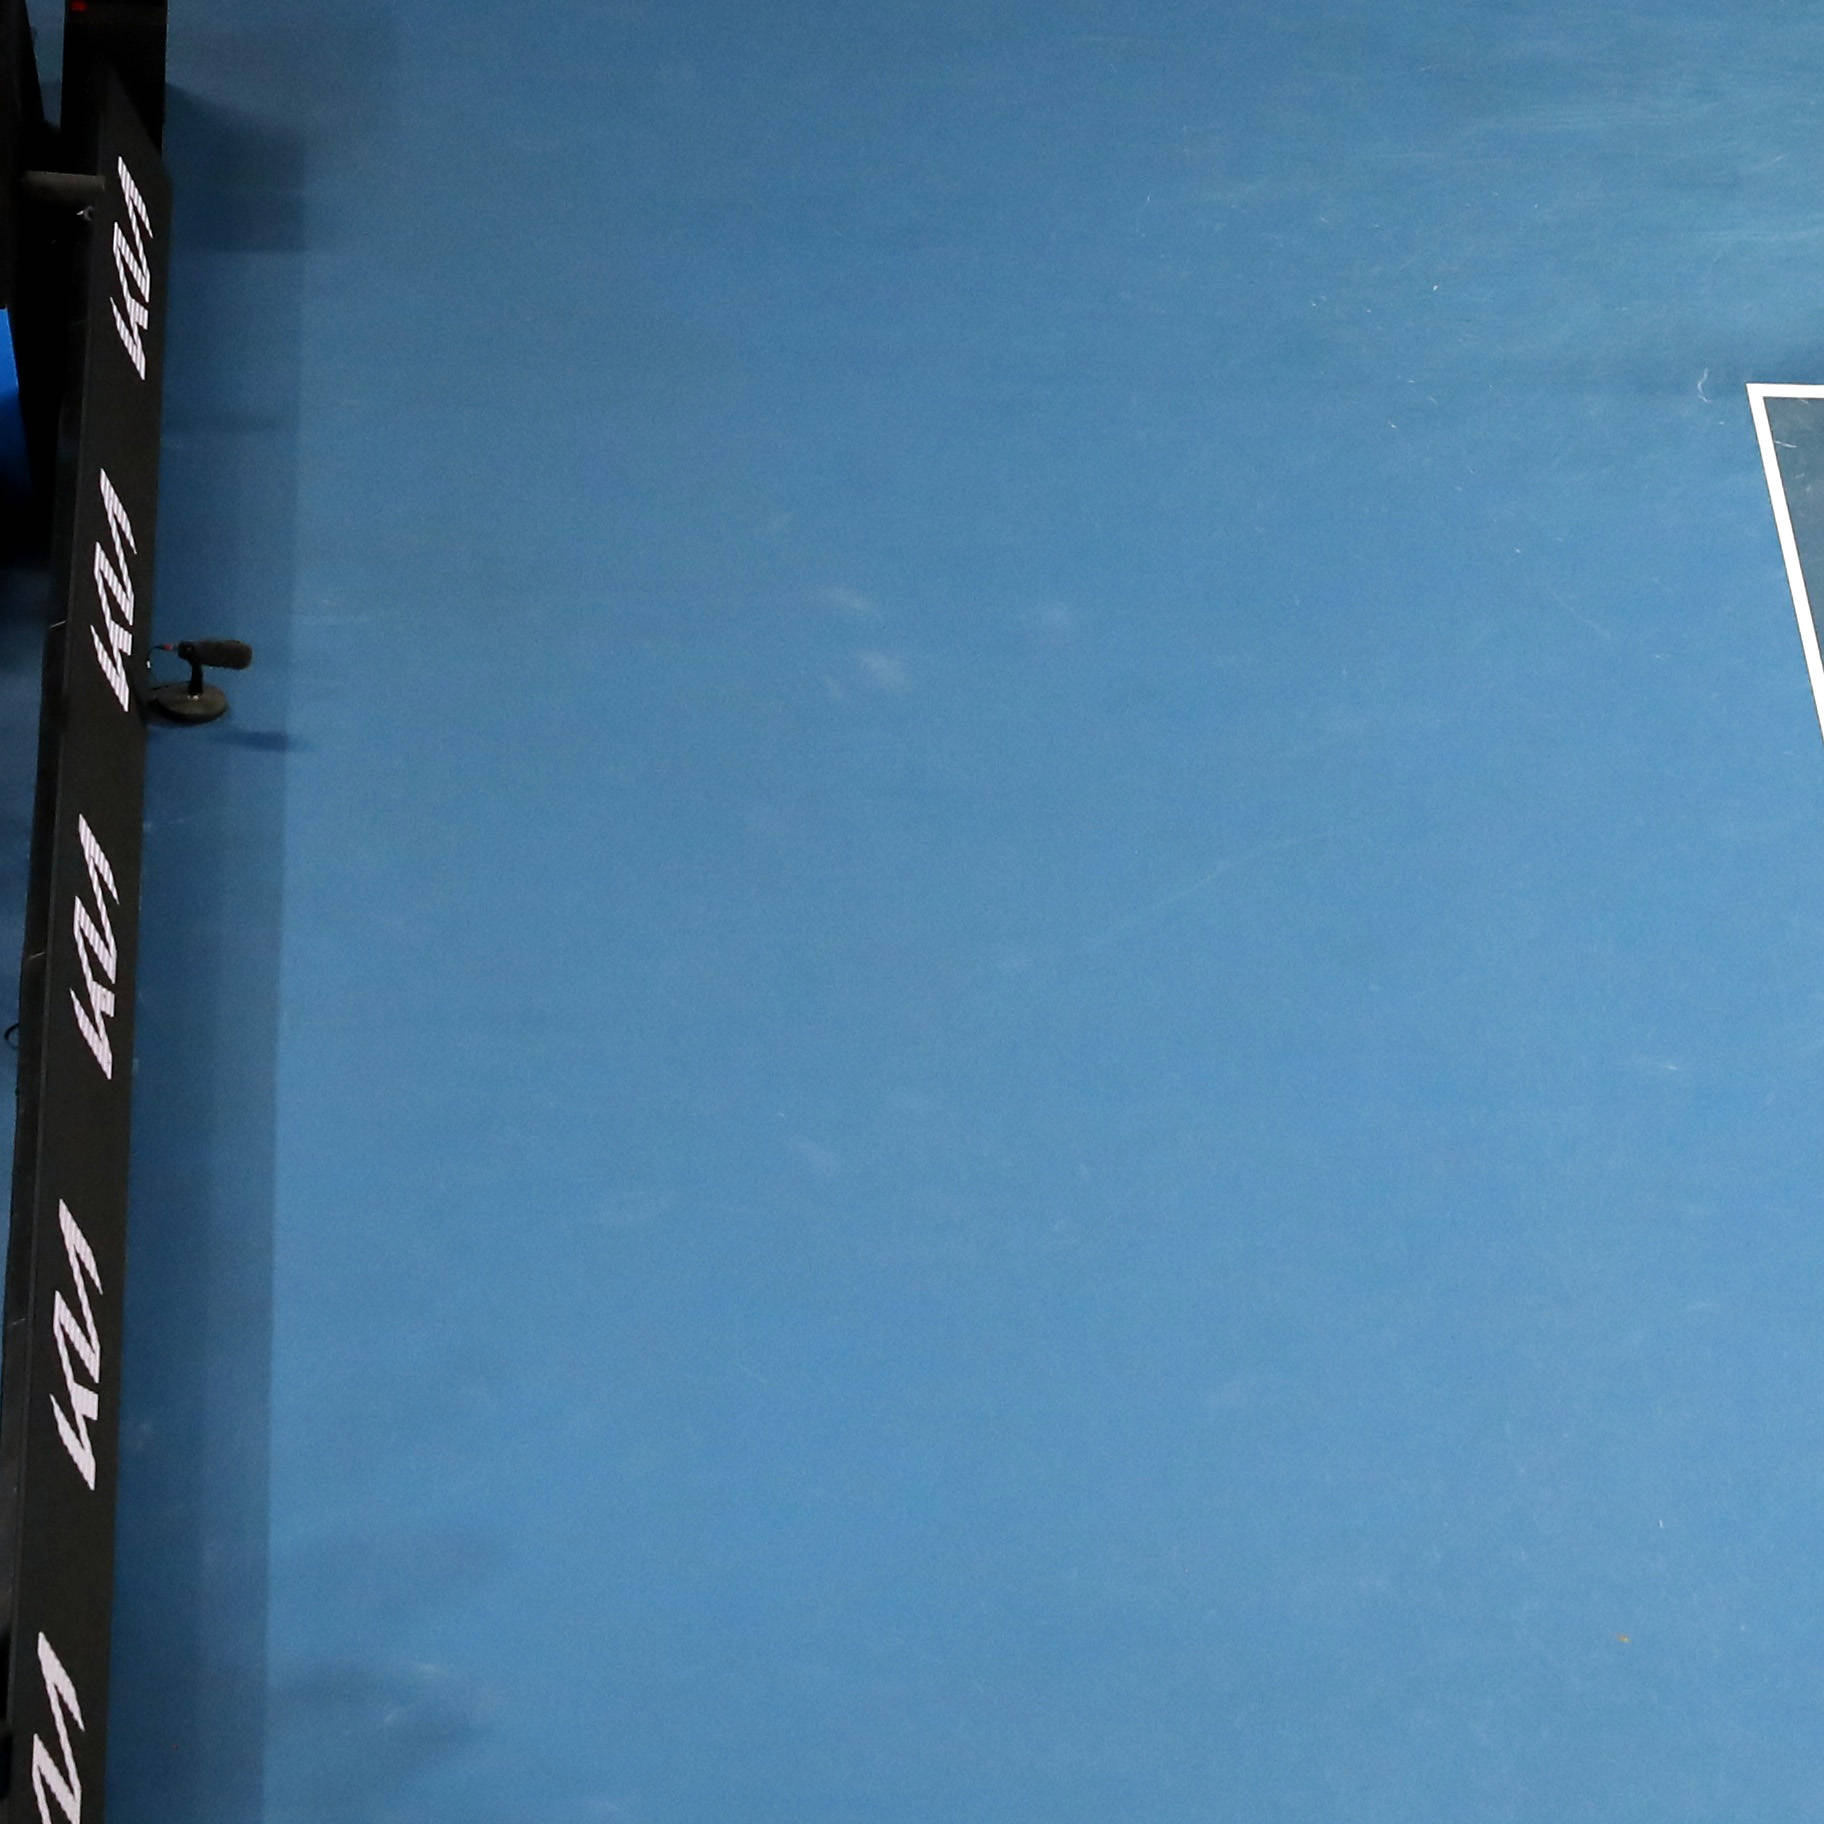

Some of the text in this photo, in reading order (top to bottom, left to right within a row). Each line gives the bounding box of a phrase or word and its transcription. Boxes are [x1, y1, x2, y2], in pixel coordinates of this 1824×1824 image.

[109, 156, 153, 380] KIA
[90, 468, 138, 713] KIA
[70, 813, 120, 1080] KIA
[49, 1198, 103, 1491] KIA
[31, 1631, 85, 1824] IA
